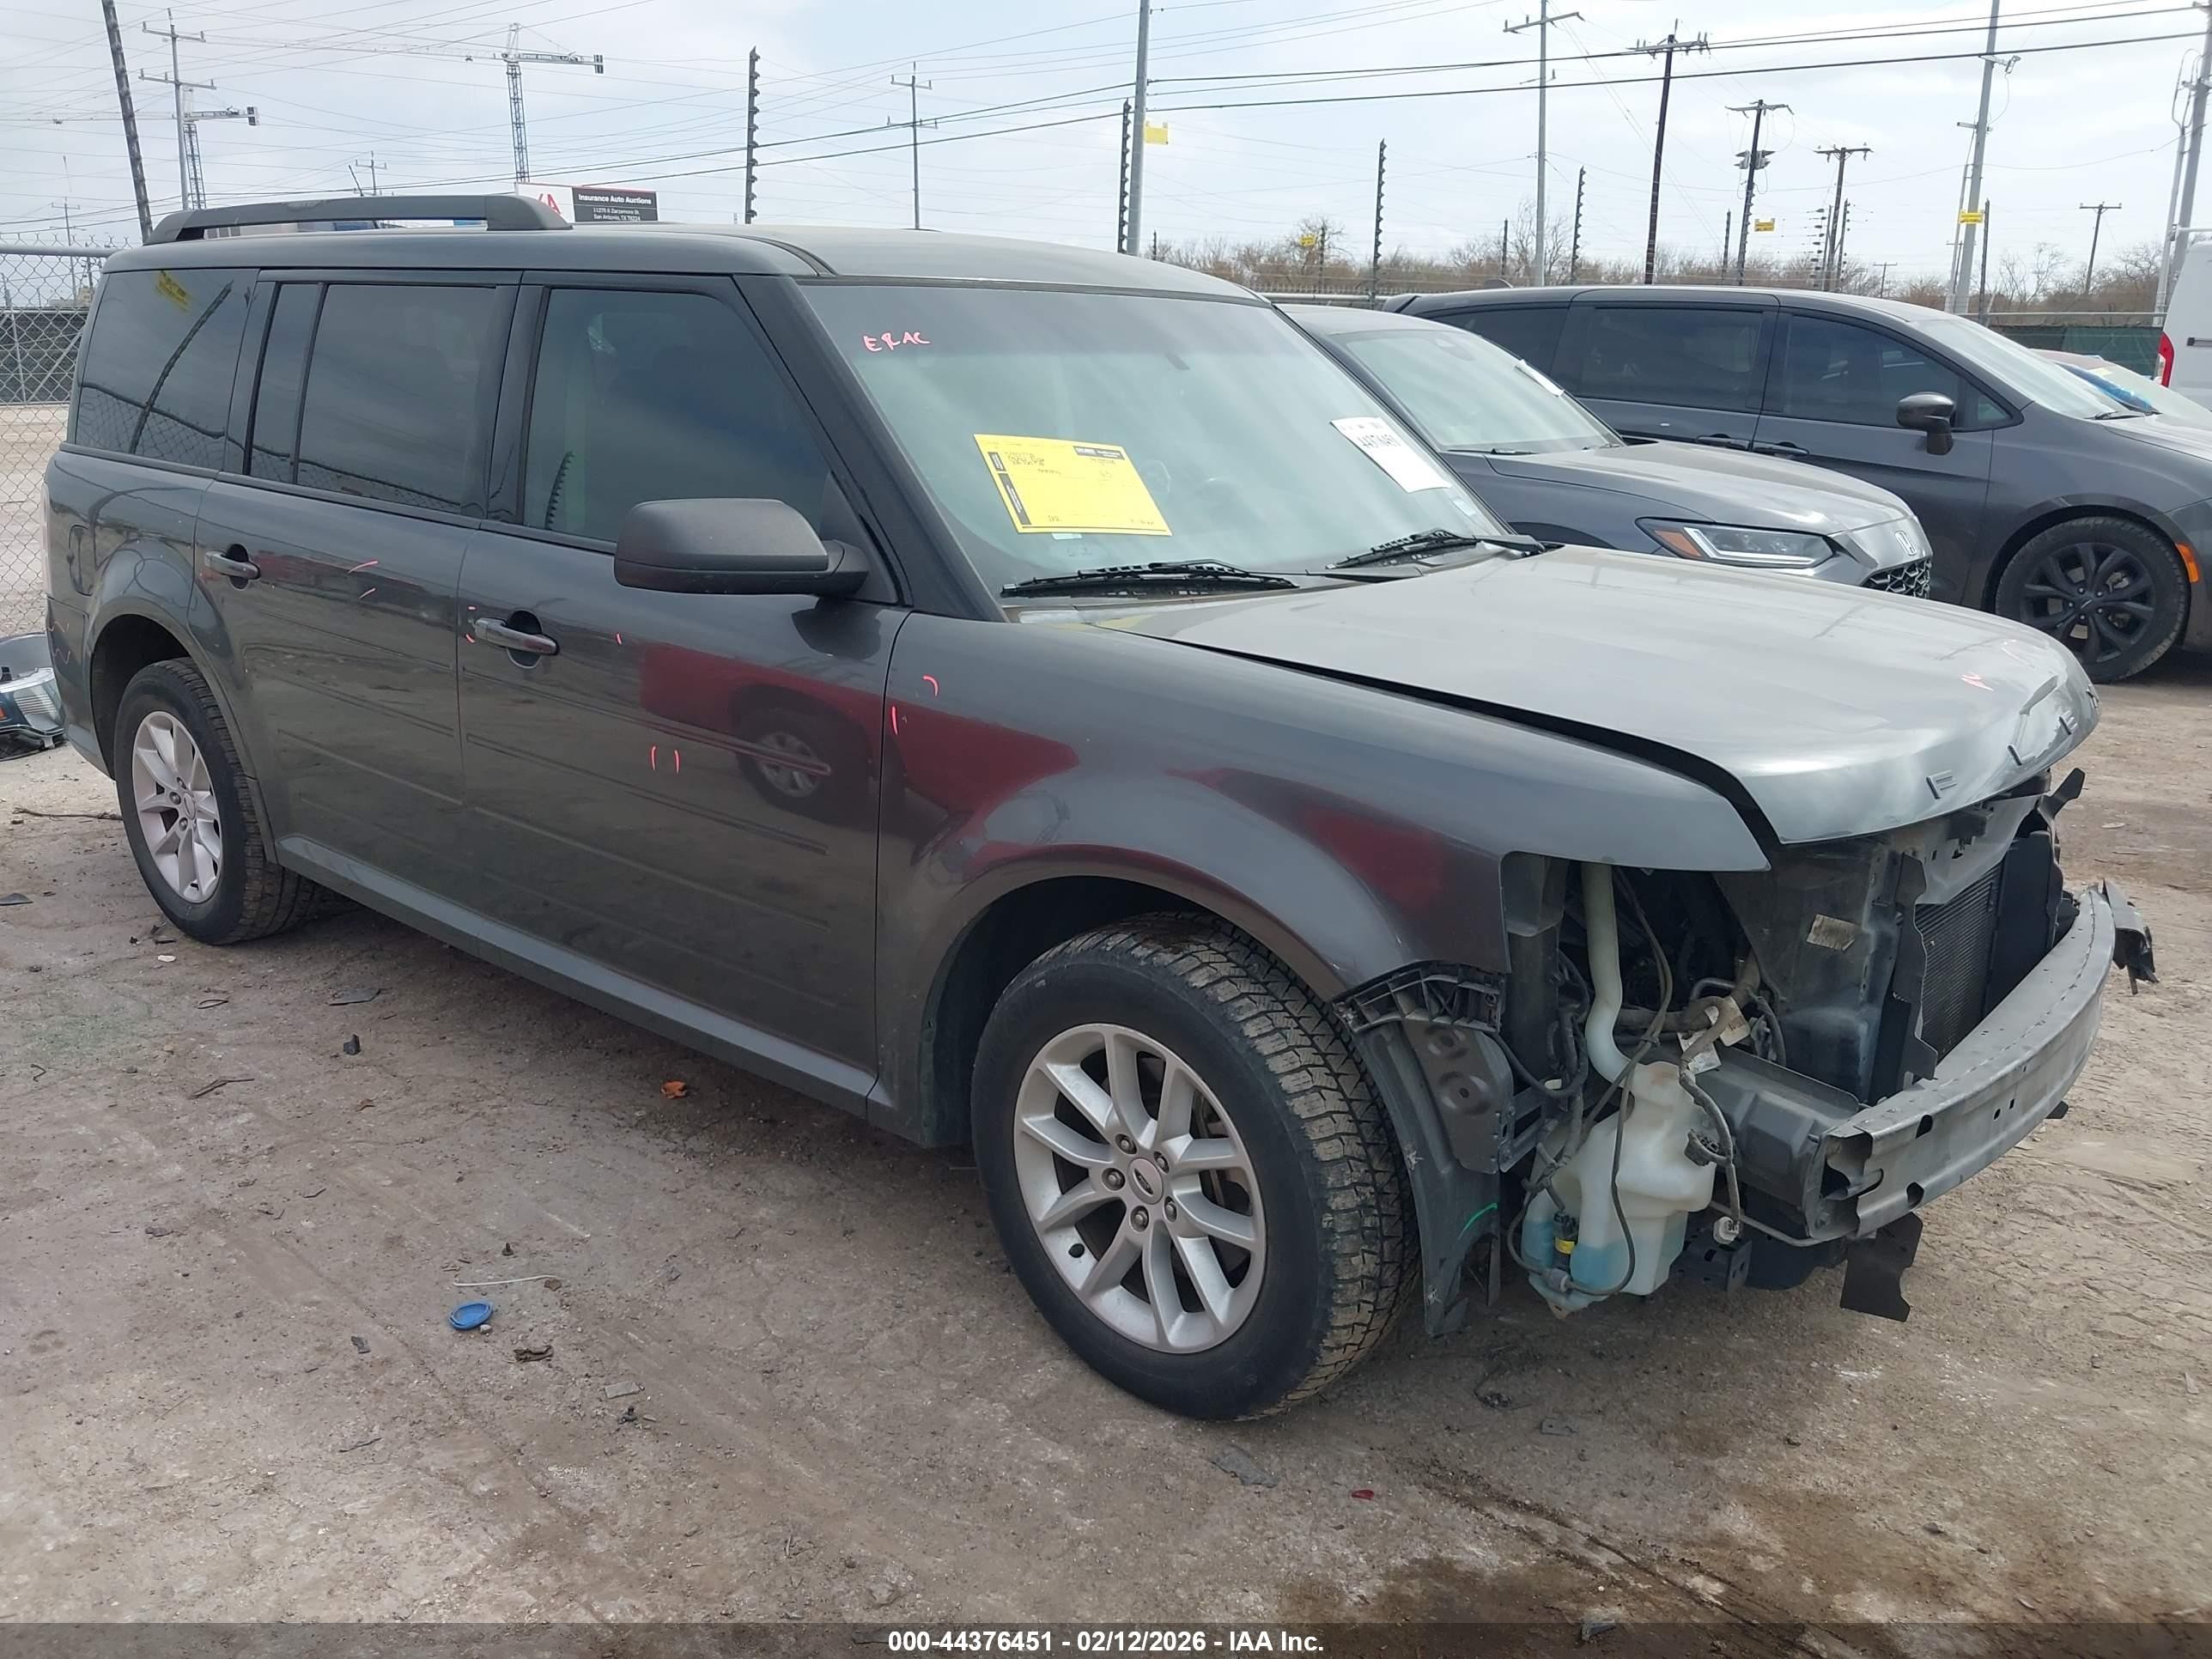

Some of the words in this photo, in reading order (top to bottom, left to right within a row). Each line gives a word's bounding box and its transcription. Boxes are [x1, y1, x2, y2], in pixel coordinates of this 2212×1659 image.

[578, 193, 609, 203] Insurance
[611, 195, 624, 204] Auto
[625, 196, 652, 205] Auctions
